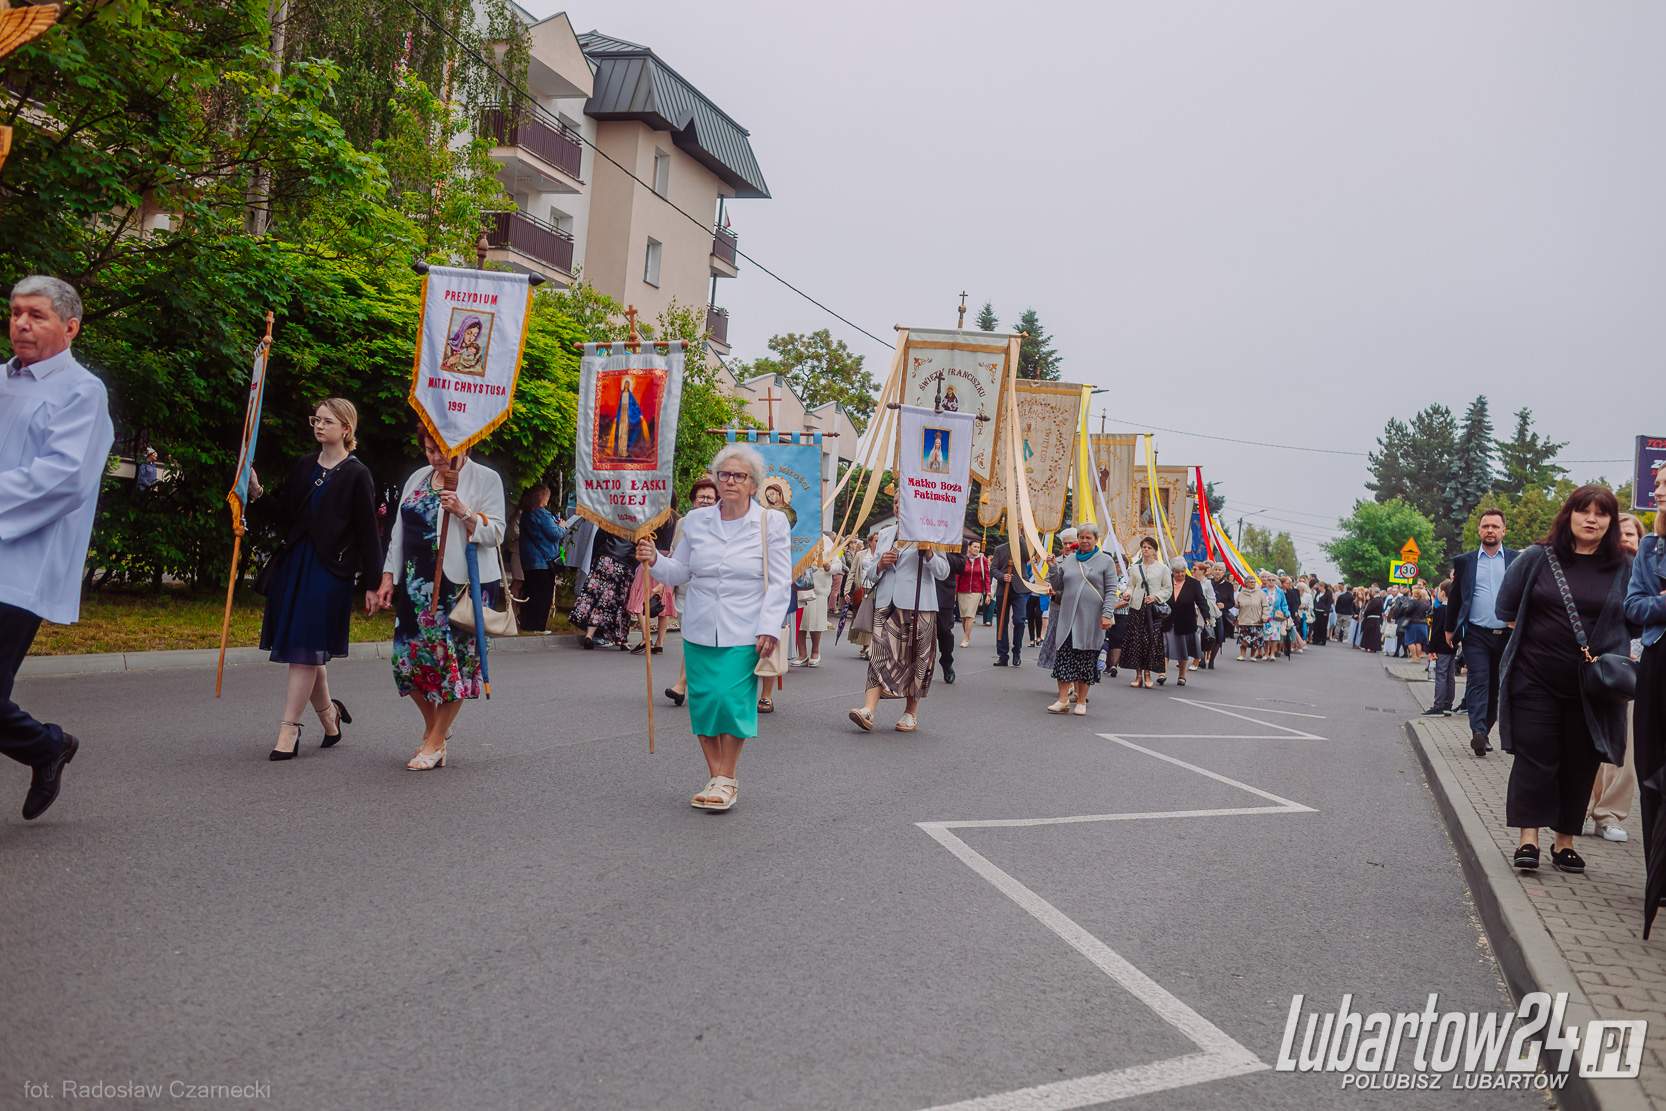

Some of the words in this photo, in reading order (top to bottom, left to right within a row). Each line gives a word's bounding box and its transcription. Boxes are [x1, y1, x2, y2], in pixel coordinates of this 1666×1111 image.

[445, 290, 498, 305] PREZYDIUM
[454, 380, 507, 396] CHRYSTUSA
[447, 400, 467, 413] 1991
[631, 479, 667, 490] ŁASKI
[908, 477, 937, 490] Matko
[940, 481, 962, 493] Boża
[914, 489, 957, 504] Fatimska
[1402, 565, 1416, 575] 30
